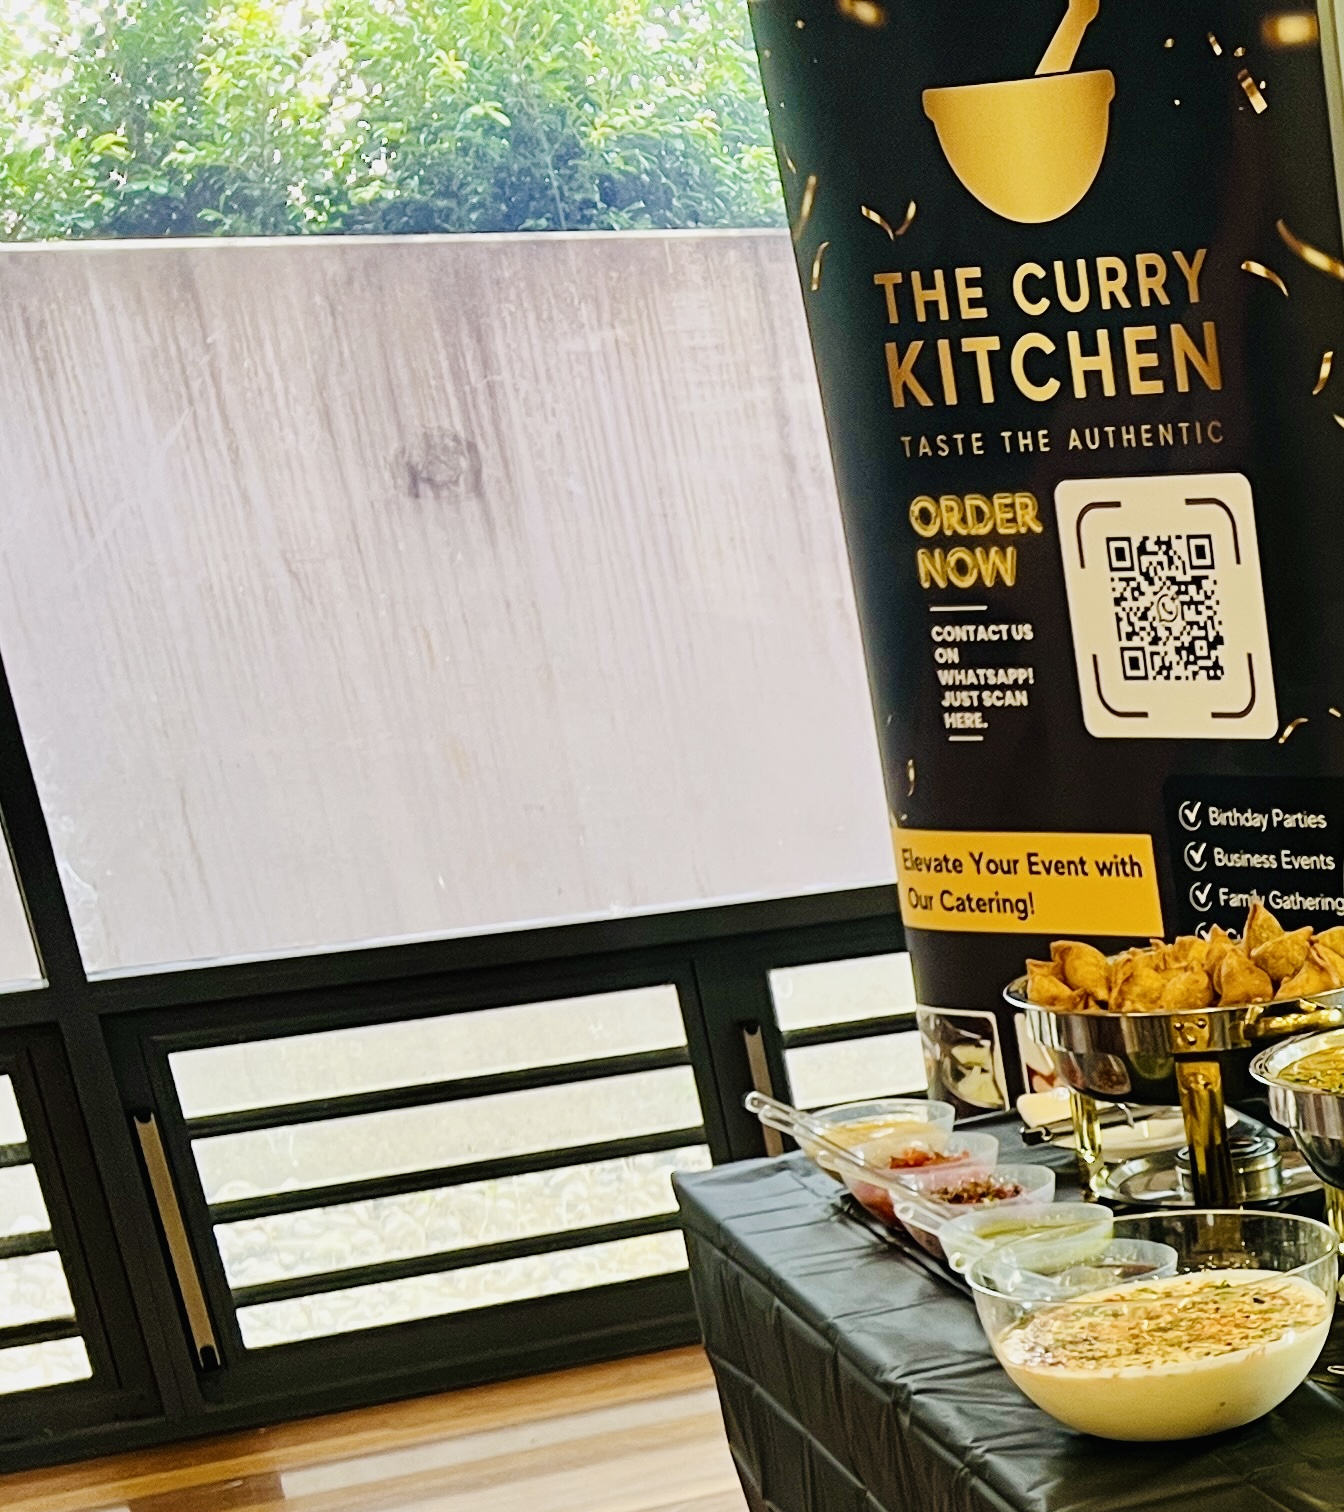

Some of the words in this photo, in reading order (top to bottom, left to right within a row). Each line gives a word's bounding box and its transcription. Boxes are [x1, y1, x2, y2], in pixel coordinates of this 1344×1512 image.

[874, 266, 988, 324] THE
[1013, 248, 1208, 316] CURRY
[884, 321, 1223, 408] KITCHEN
[901, 432, 985, 458] TASTE
[1001, 429, 1052, 453] THE
[1068, 421, 1225, 451] AUTHENTIC
[908, 492, 1043, 538] ORDER
[917, 546, 1018, 589] NOW
[931, 625, 1009, 642] CONTACT
[1011, 624, 1034, 641] US
[934, 647, 960, 664] ON
[936, 667, 1035, 686] WHATSAPP!
[941, 690, 980, 707] JUST
[981, 690, 1029, 707] SCAN
[943, 712, 989, 729] HERE.
[1208, 806, 1269, 832] Birthday
[1272, 808, 1328, 829] Parties
[901, 848, 964, 874] Elevate
[968, 851, 1021, 876] Your
[1026, 852, 1089, 877] Event
[1095, 854, 1143, 878] with
[1213, 847, 1278, 870] Business
[1281, 850, 1336, 870] Events
[907, 887, 934, 912] Our
[940, 889, 1035, 921] Catering!
